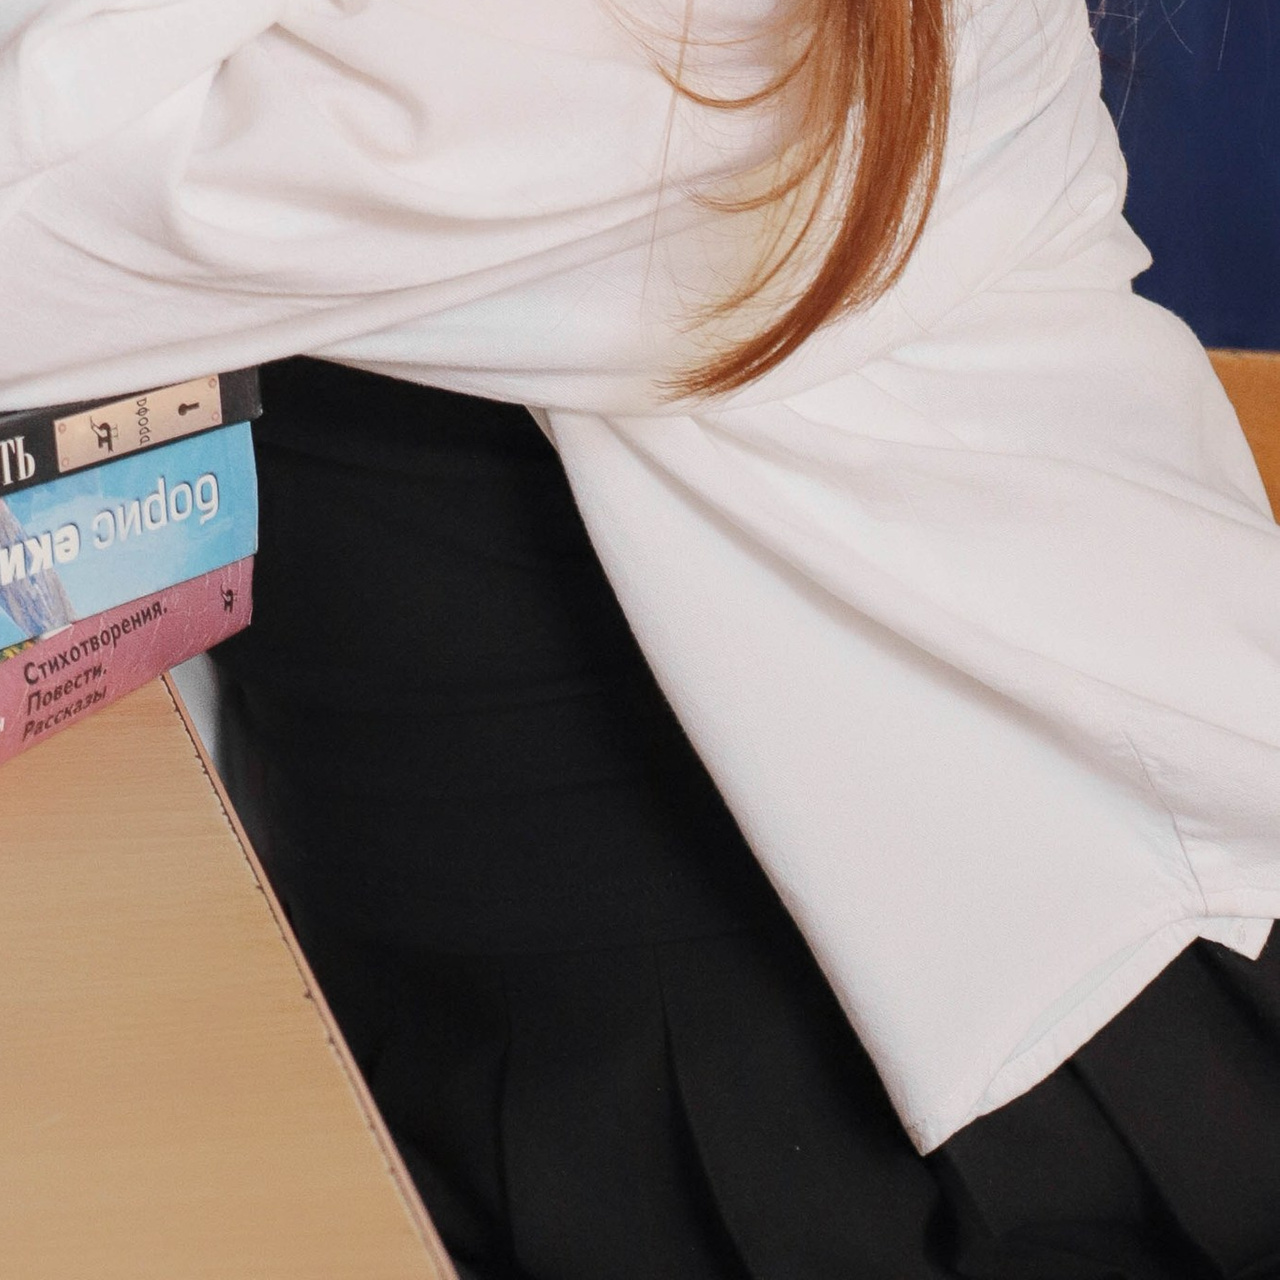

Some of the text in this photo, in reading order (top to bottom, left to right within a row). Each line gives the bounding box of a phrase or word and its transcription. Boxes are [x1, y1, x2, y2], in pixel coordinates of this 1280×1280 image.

[91, 471, 220, 551] борис
[22, 598, 169, 687] Стихотворения.
[21, 685, 107, 743] Рассказы
[25, 661, 108, 717] Повести.
